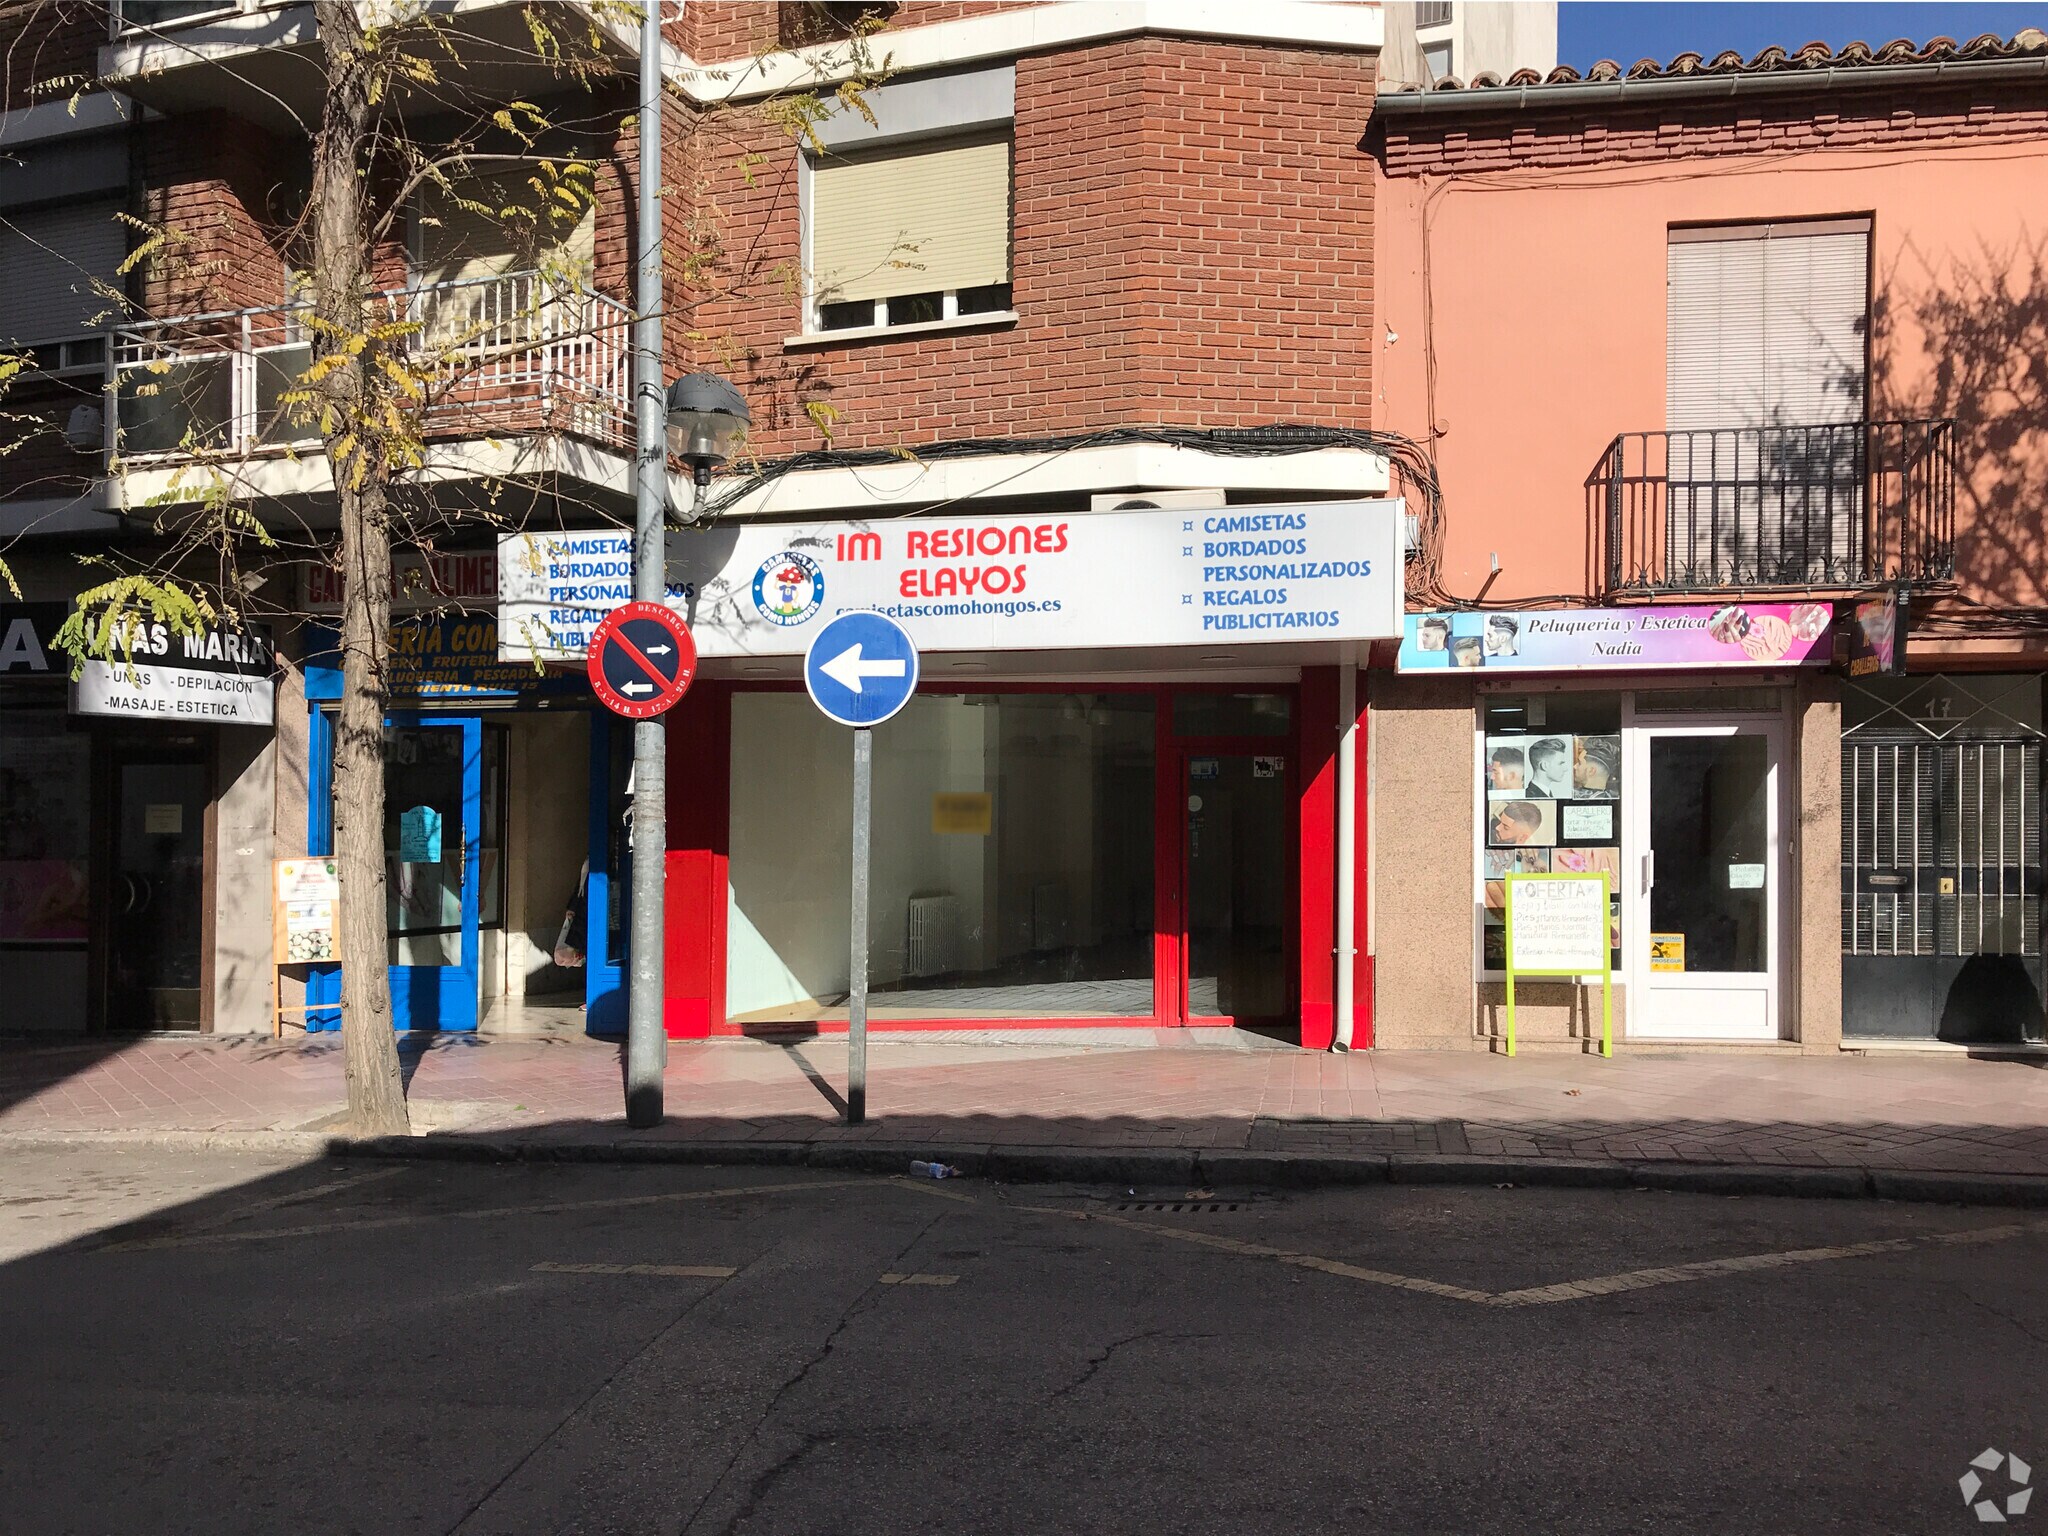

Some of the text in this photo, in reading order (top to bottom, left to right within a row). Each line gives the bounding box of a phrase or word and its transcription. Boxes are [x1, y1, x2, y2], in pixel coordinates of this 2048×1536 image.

[1204, 513, 1306, 534] CAMISETAS
[838, 523, 1068, 561] IM RESIONES
[1203, 538, 1306, 558] BORDADOS
[900, 564, 1027, 598] ELAYOS
[1203, 560, 1371, 582] PERSONALIZADOS
[1203, 588, 1287, 606] REGALOS
[759, 600, 820, 625] COMO HONGOS
[1203, 610, 1340, 630] PUBLICITARIOS
[590, 604, 685, 659] CARGA Y DESCARGA
[1528, 615, 1707, 636] Peluqueria y Estetica
[183, 630, 267, 665] MARIA
[1591, 641, 1642, 656] Nadia
[393, 682, 472, 694] TENIENTE
[477, 681, 513, 692] RUIZ
[177, 700, 238, 716] ESTETICA
[1925, 698, 1952, 718] 17
[1524, 881, 1586, 898] OFERTA
